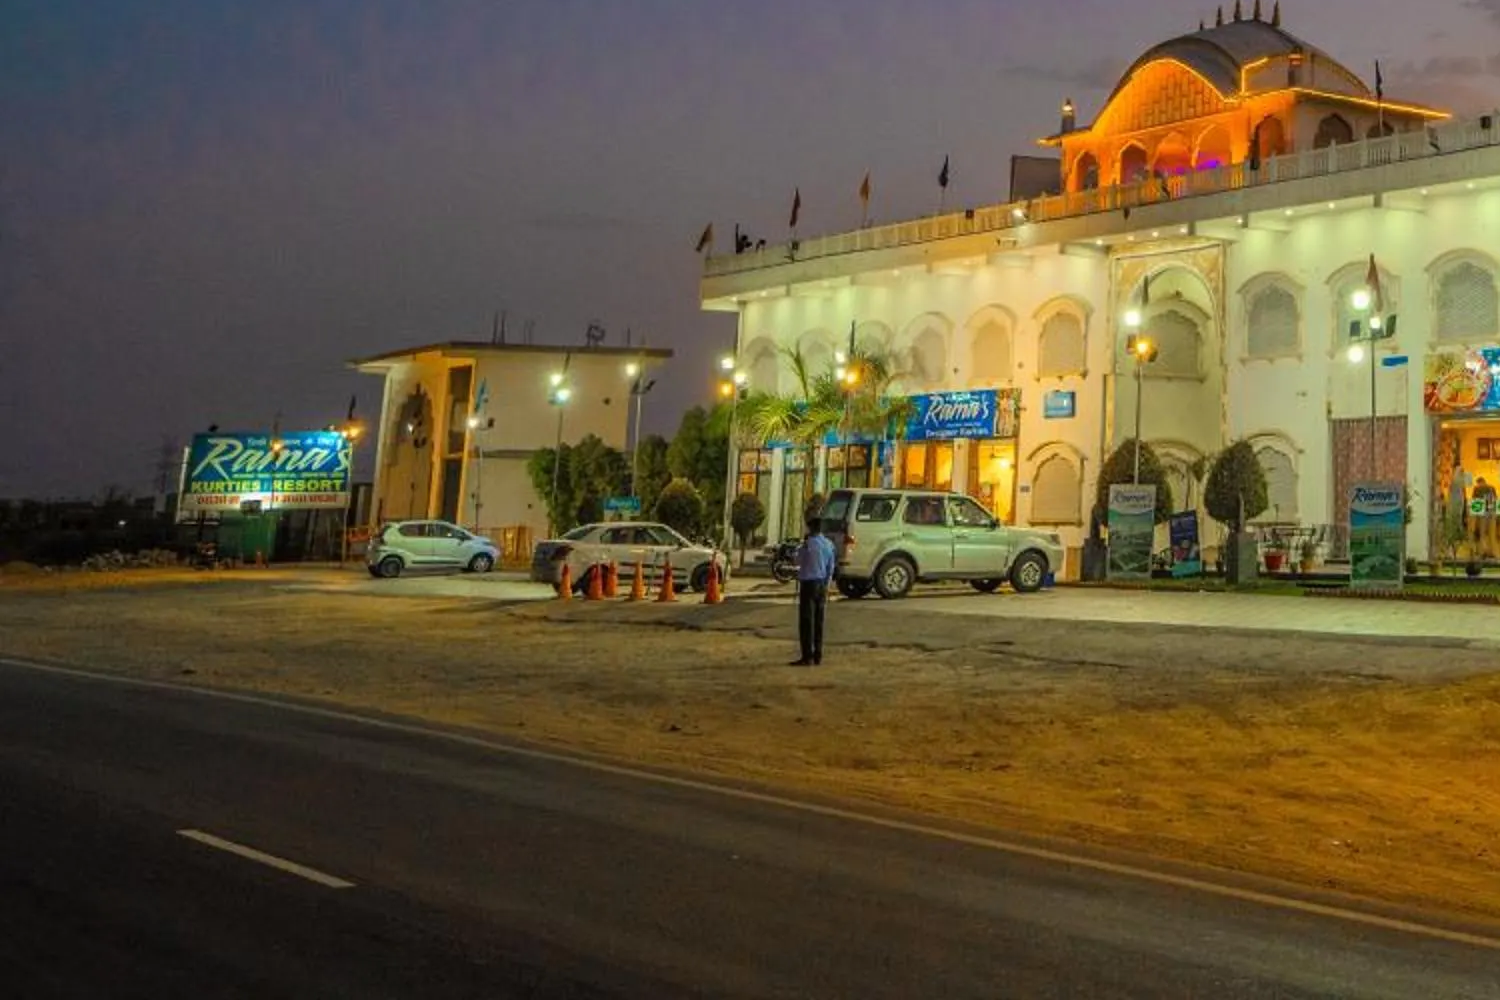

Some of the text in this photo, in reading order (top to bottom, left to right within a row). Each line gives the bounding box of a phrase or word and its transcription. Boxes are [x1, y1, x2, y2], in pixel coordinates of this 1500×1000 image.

[924, 391, 989, 428] Rama's
[191, 437, 351, 480] Rama's
[273, 479, 345, 492] RESORT
